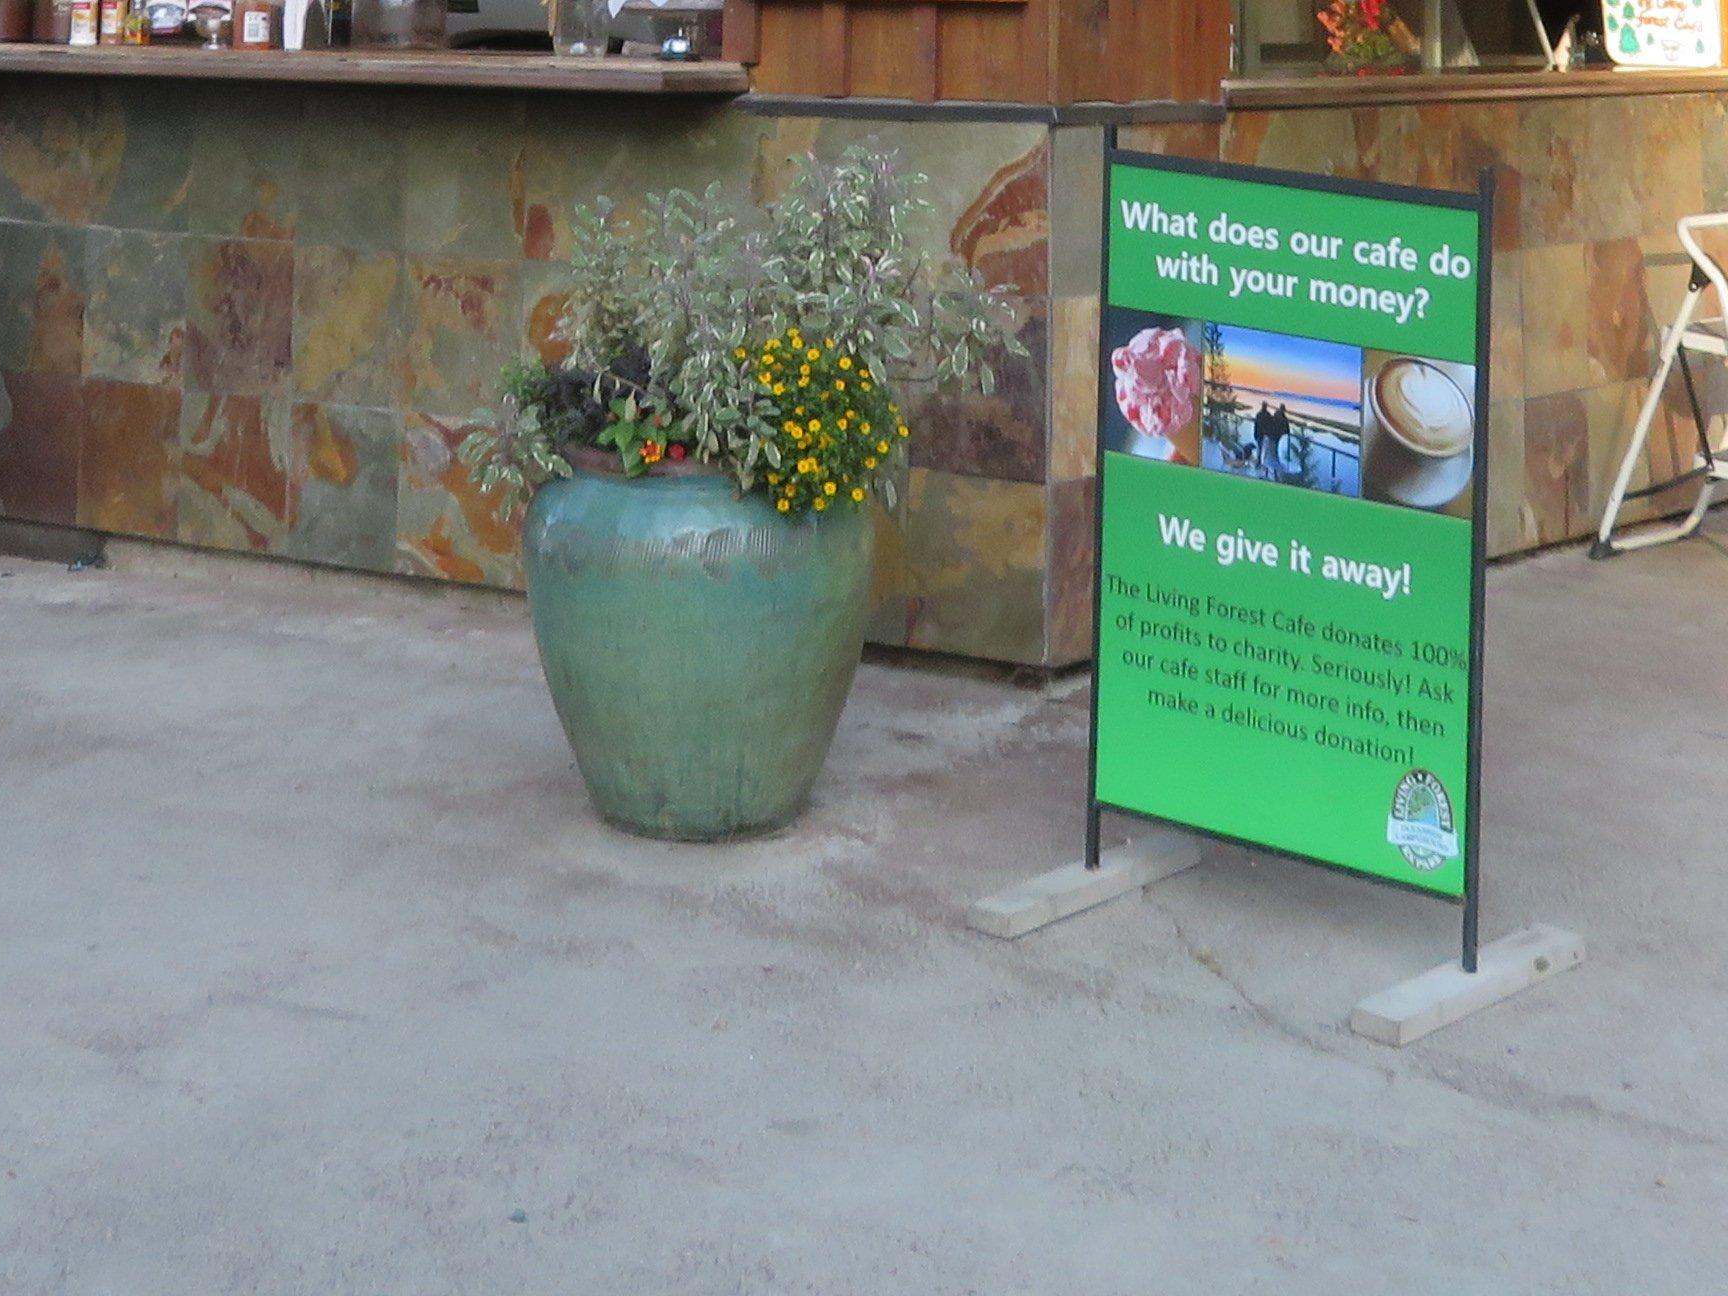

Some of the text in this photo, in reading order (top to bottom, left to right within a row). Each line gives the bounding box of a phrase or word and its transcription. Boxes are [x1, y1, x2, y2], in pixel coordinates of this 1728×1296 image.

[1121, 198, 1472, 279] What does our cafe do
[1156, 251, 1430, 325] with your money?
[1158, 513, 1412, 600] We give it away!
[1107, 573, 1468, 671] The Living Forest Cafe donates 100%
[1115, 611, 1454, 704] of profits to charity. Seriously! Ask
[1122, 649, 1446, 738] our cafe staff for more info, then
[1148, 688, 1415, 767] make a delicious donation!
